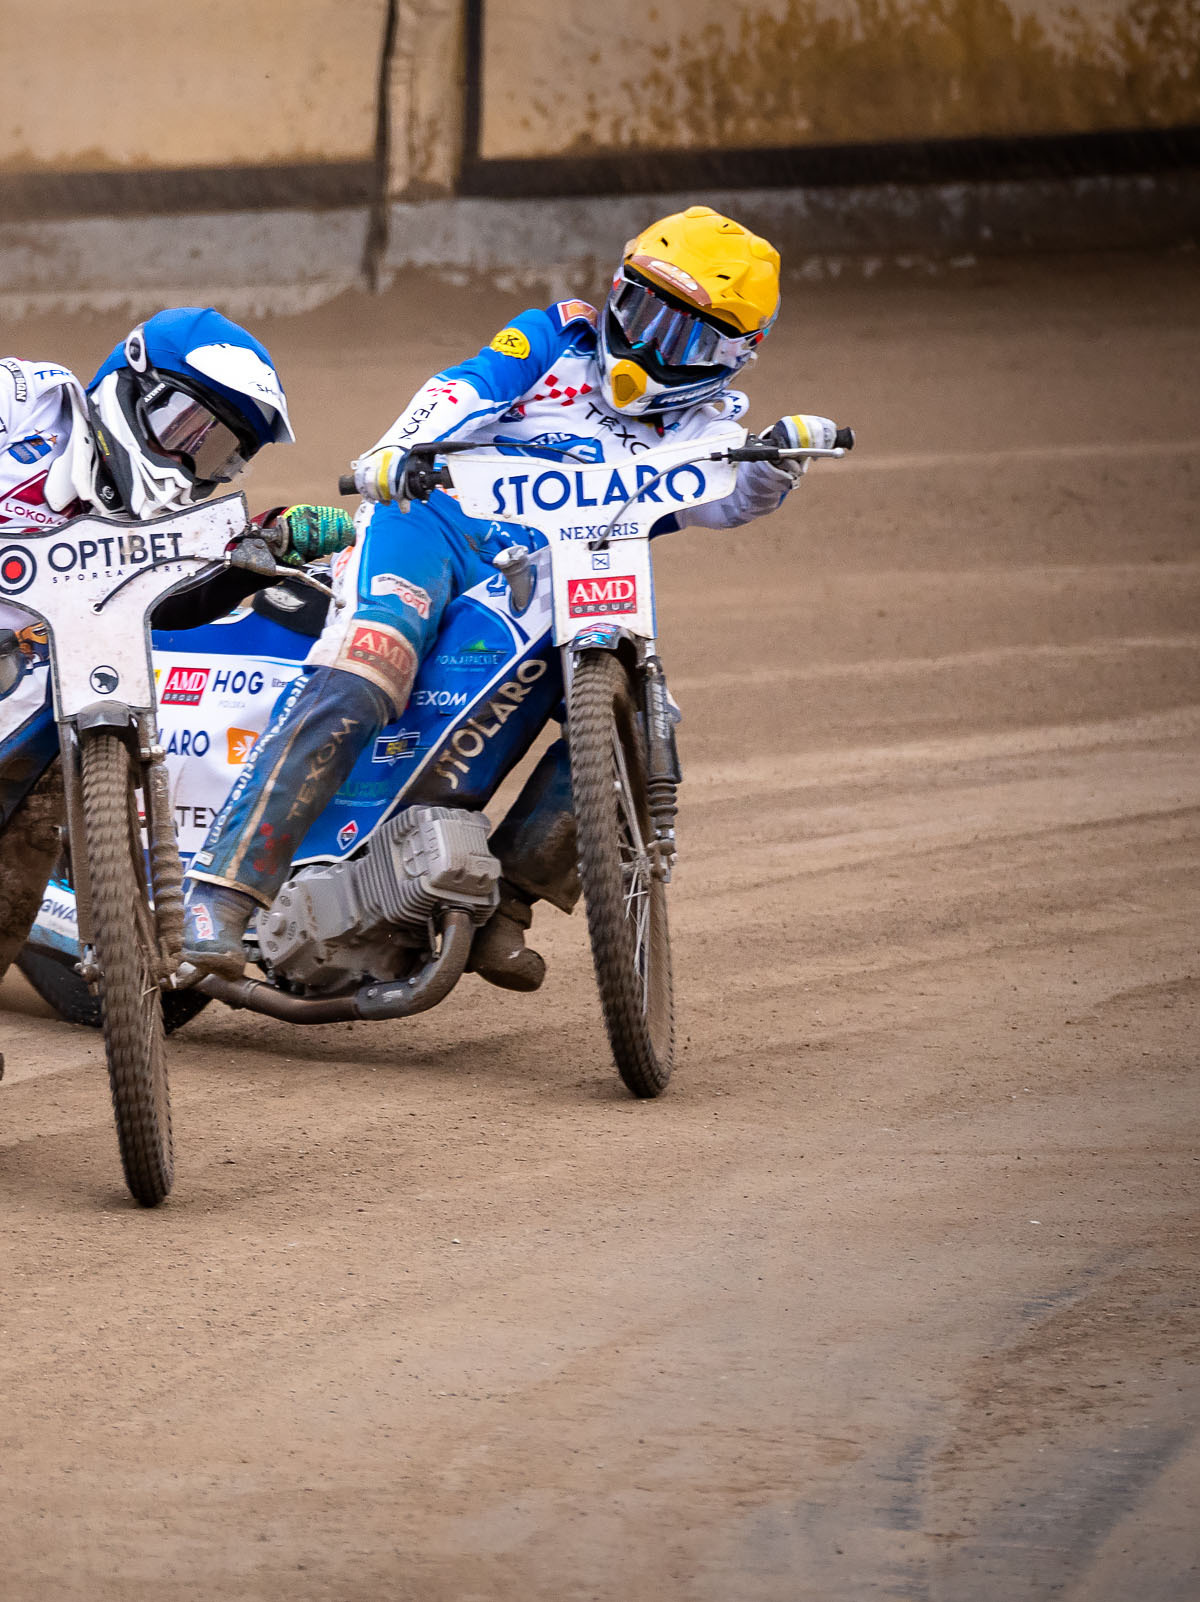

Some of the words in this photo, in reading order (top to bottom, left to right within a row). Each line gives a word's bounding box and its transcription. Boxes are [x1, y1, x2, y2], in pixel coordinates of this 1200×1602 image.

[492, 463, 706, 515] STOLARO
[560, 522, 639, 541] NEXORIS
[48, 532, 183, 572] OPTIBET
[571, 580, 635, 603] AMD
[573, 602, 633, 613] GROUP
[165, 671, 208, 692] AMD
[212, 670, 264, 695] HOG
